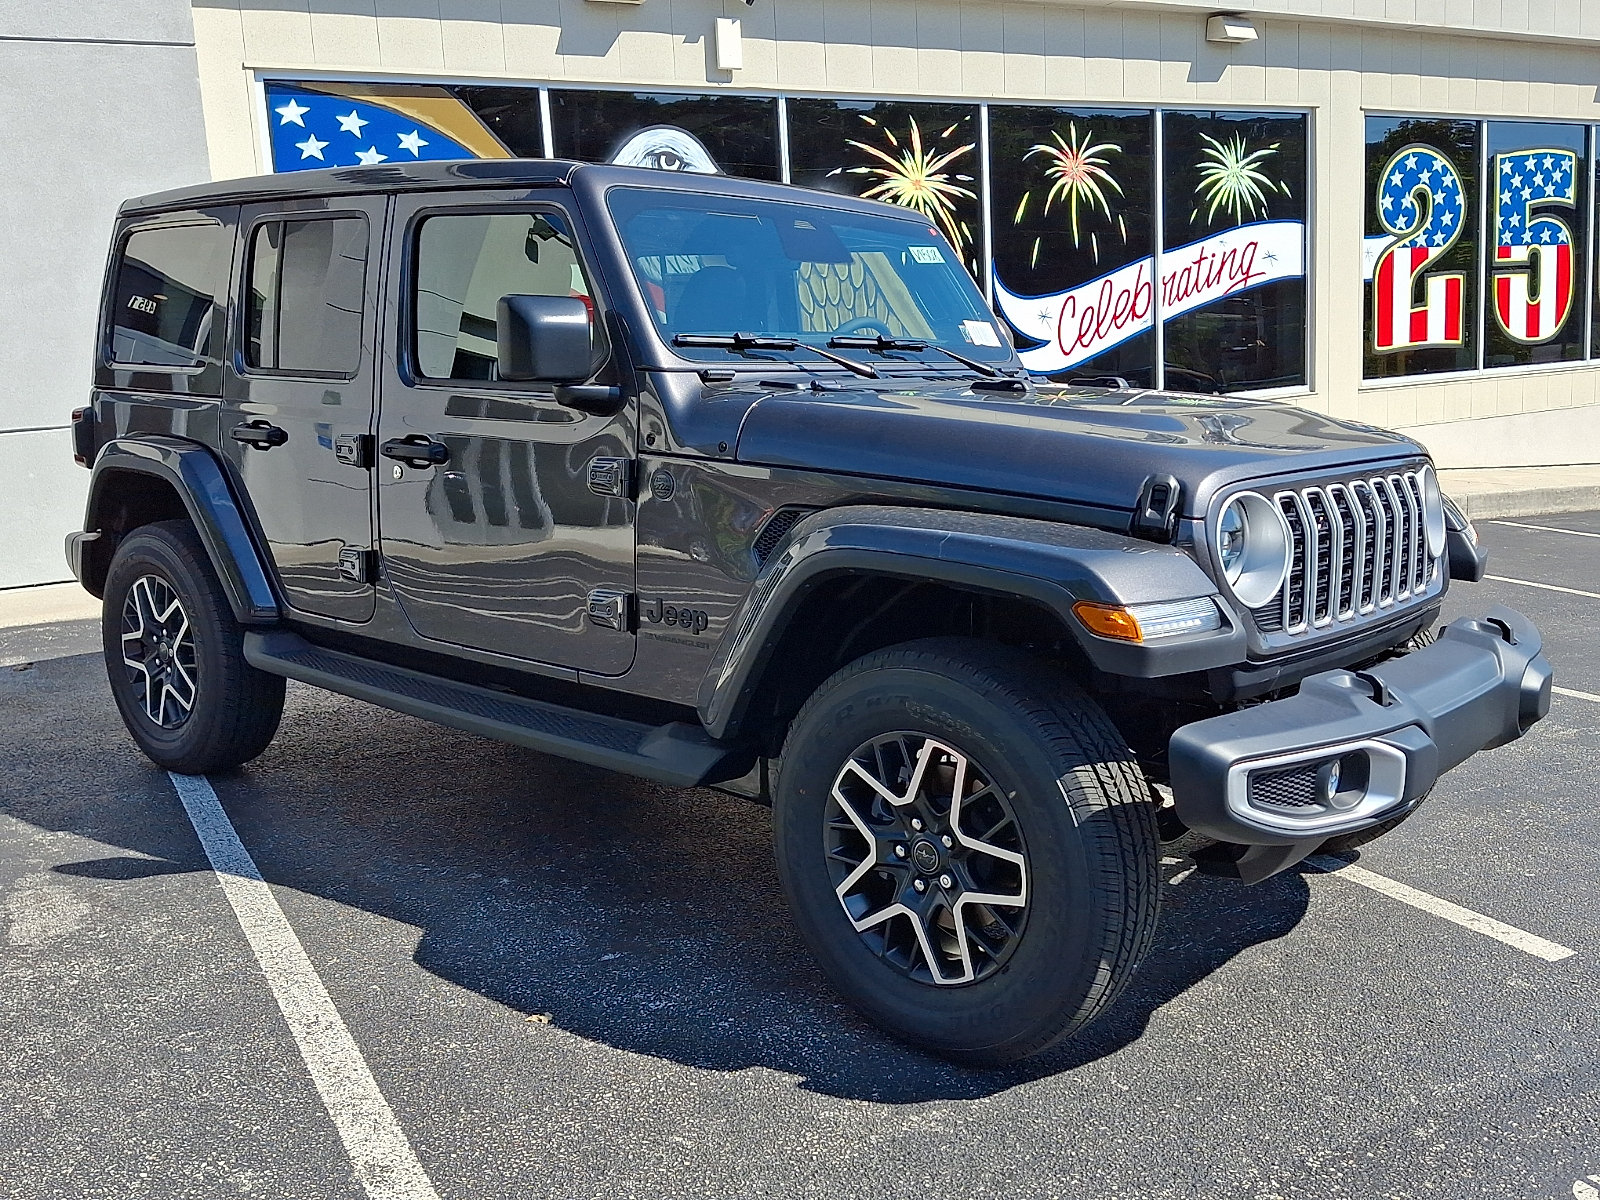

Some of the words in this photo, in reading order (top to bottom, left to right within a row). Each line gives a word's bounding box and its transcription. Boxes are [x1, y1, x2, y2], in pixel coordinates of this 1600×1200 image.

[1057, 241, 1266, 356] Celebrating
[1373, 143, 1577, 354] 25
[646, 598, 709, 635] Jeep
